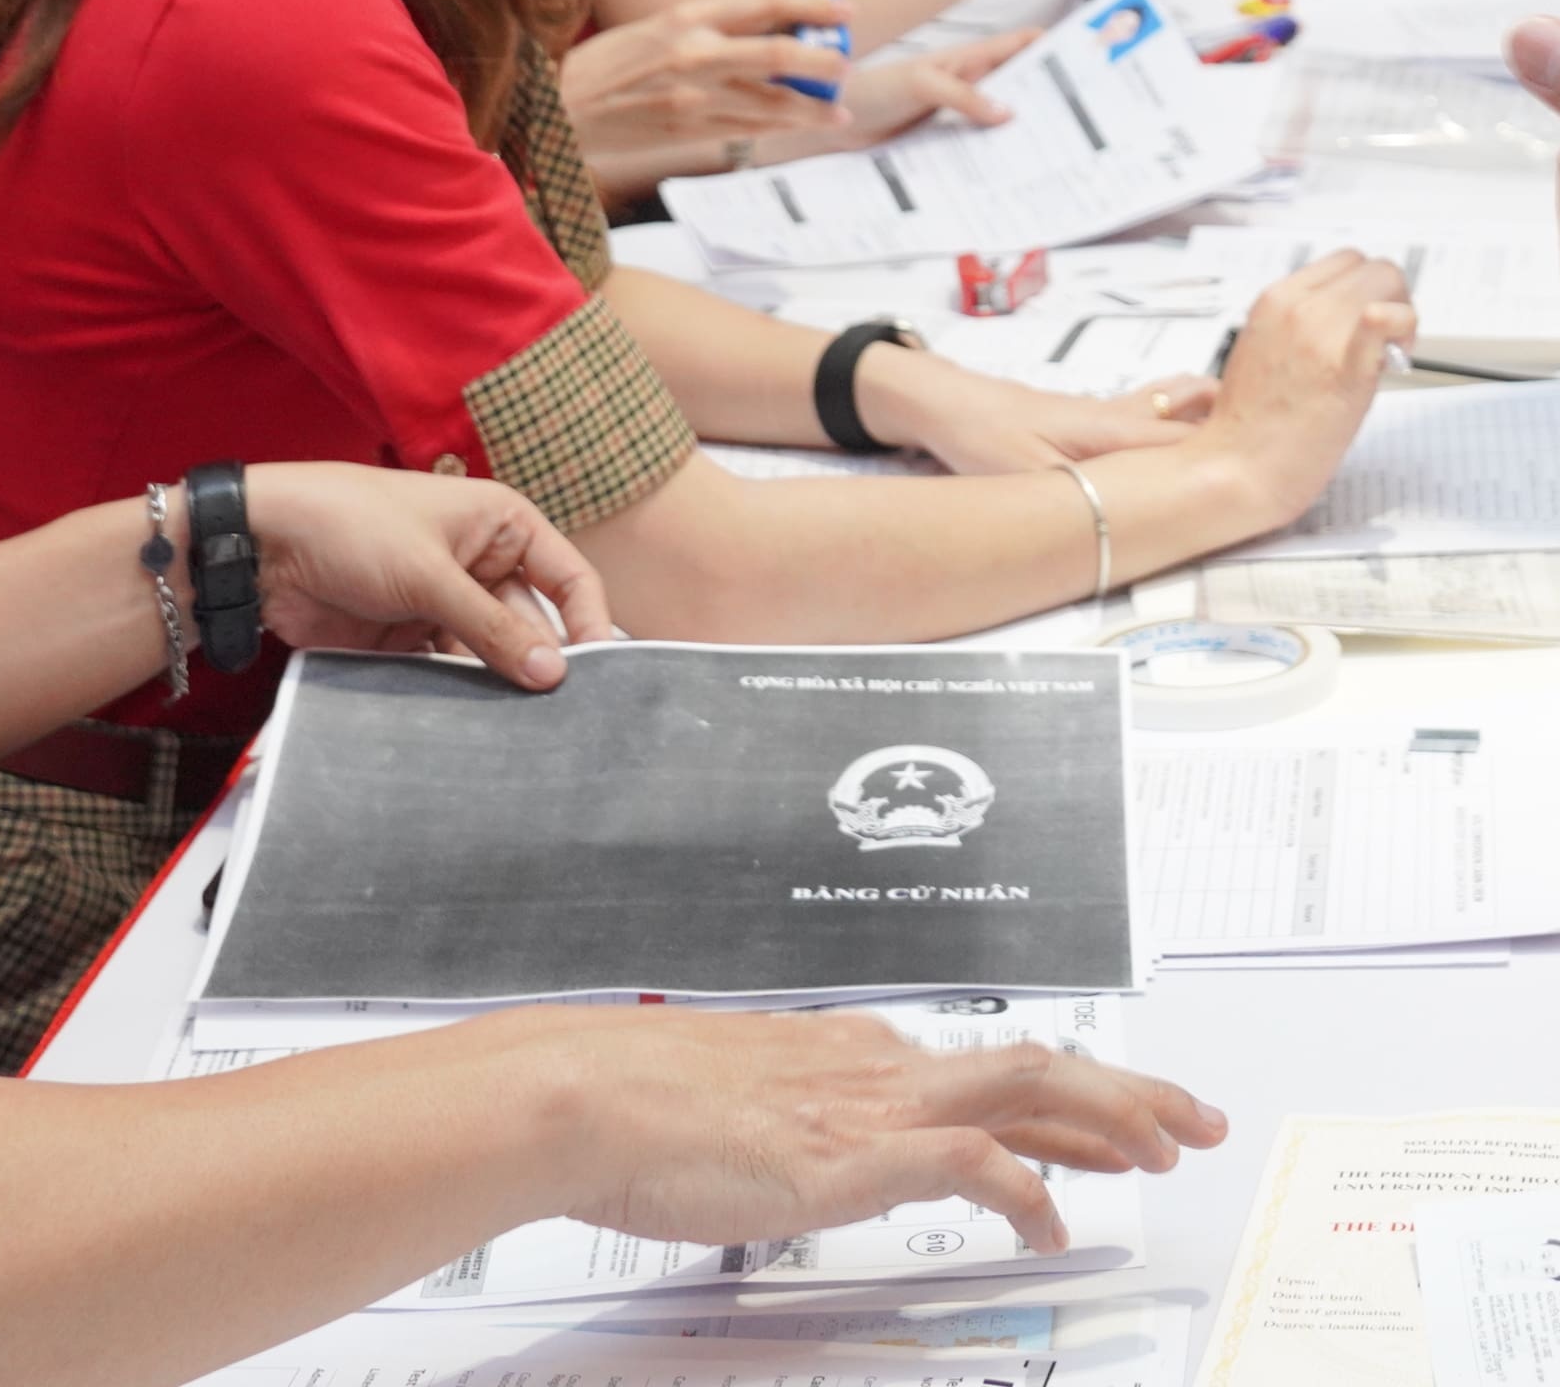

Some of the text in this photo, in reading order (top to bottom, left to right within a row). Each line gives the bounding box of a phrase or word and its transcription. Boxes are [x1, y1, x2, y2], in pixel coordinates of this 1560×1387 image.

[940, 883, 1031, 900] NHÂN
[1075, 1000, 1096, 1031] TOEIC
[1330, 1222, 1381, 1232] THE
[927, 1233, 945, 1253] 610
